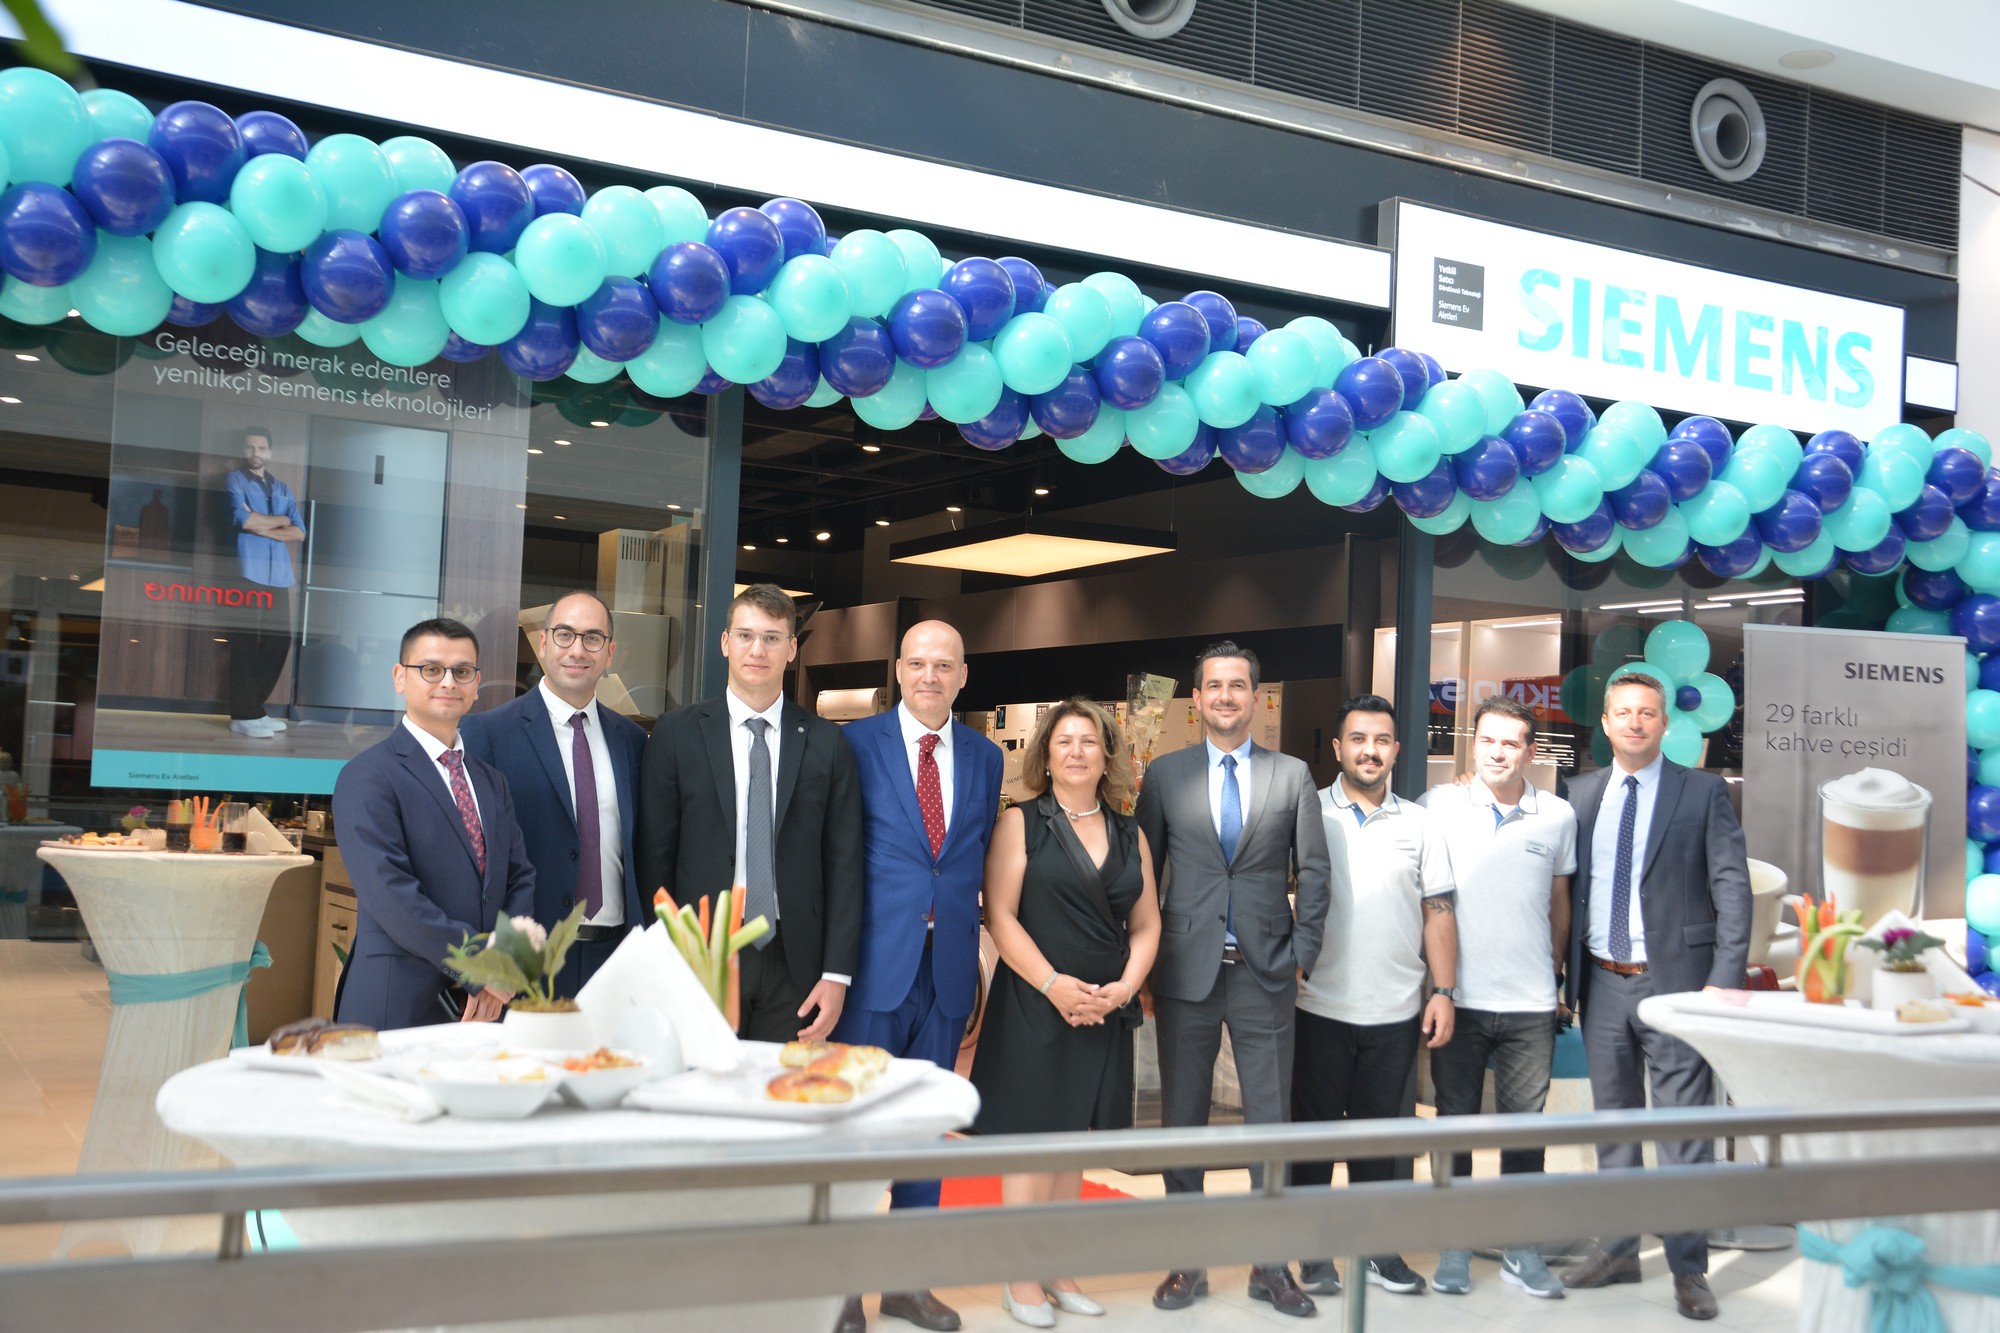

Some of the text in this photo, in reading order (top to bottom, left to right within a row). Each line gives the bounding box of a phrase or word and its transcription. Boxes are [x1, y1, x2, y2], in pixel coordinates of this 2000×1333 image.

[1437, 310, 1458, 321] Aletleri
[1438, 300, 1470, 313] Siemens Ev
[1518, 268, 1875, 409] SIEMENS
[155, 332, 452, 389] Geleceği merak edenlere
[153, 363, 252, 394] yenilikçi
[257, 374, 357, 405] Siemens
[362, 389, 492, 421] teknolojileri
[1844, 661, 1944, 684] SIEMENS
[1765, 703, 1858, 727] 29 farklı
[1766, 731, 1907, 760] kahve çeşidi
[128, 771, 160, 780] Siemens
[172, 773, 199, 781] Aletleri
